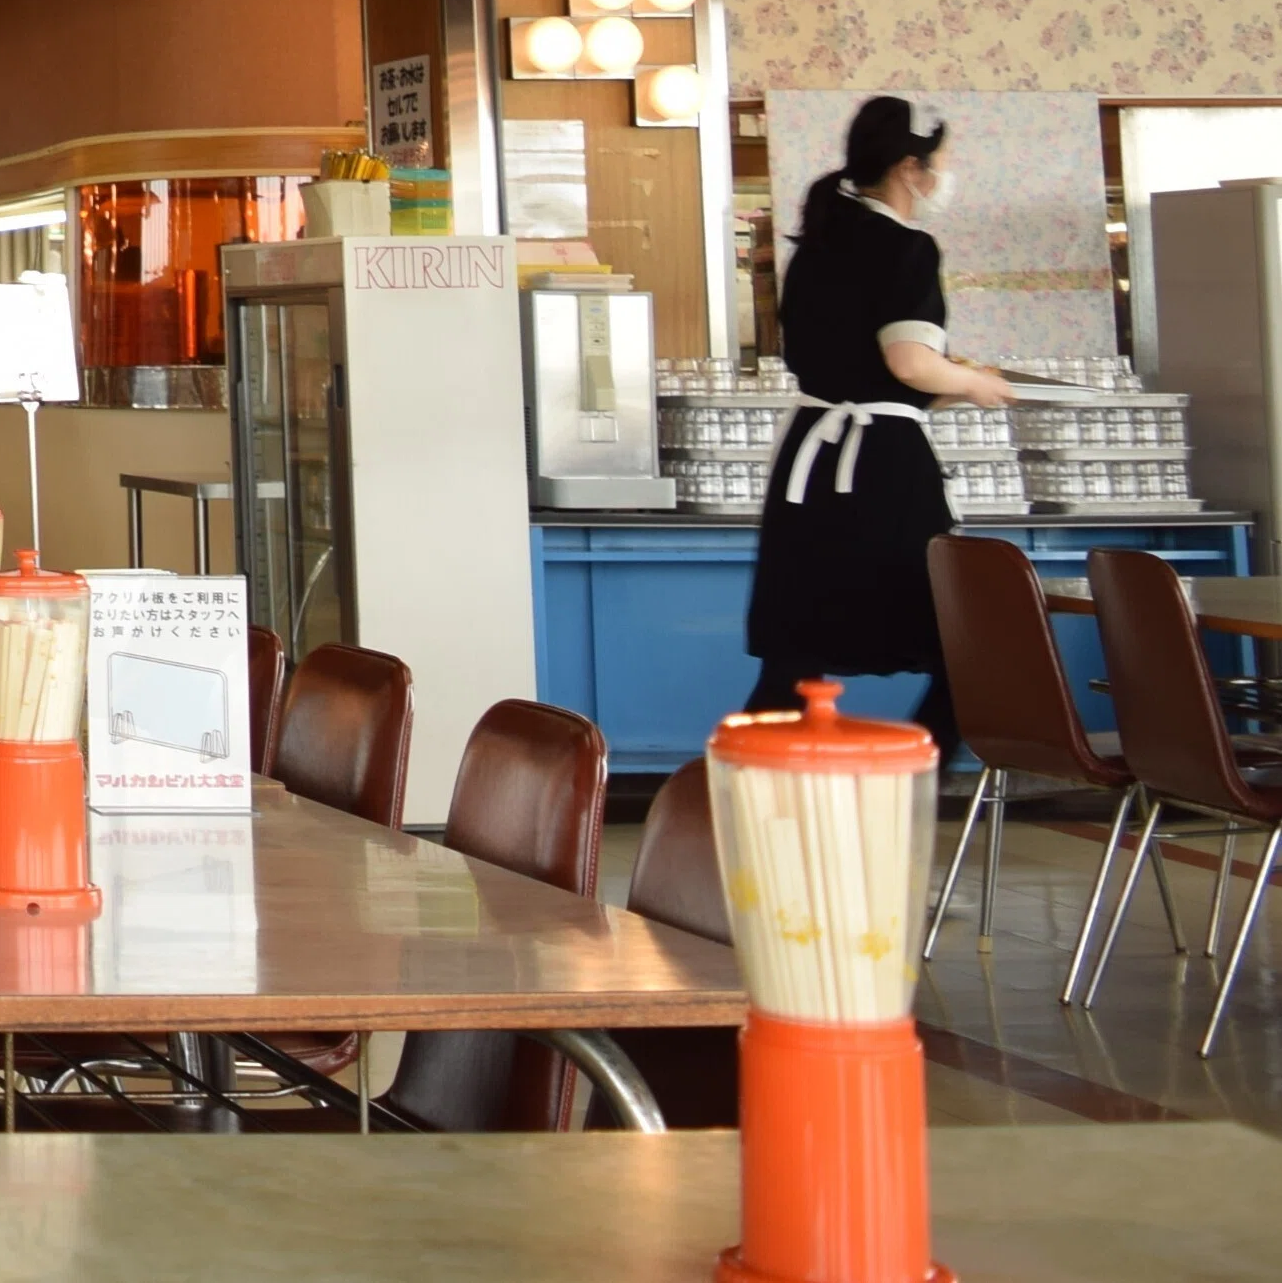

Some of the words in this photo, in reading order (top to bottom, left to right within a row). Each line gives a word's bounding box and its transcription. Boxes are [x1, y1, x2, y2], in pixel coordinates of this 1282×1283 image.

[354, 244, 505, 290] KIRIN
[92, 592, 239, 605] アクリル板をご利用に
[92, 608, 240, 622] なりたい方はスタッフへ
[93, 625, 240, 638] お声がけください
